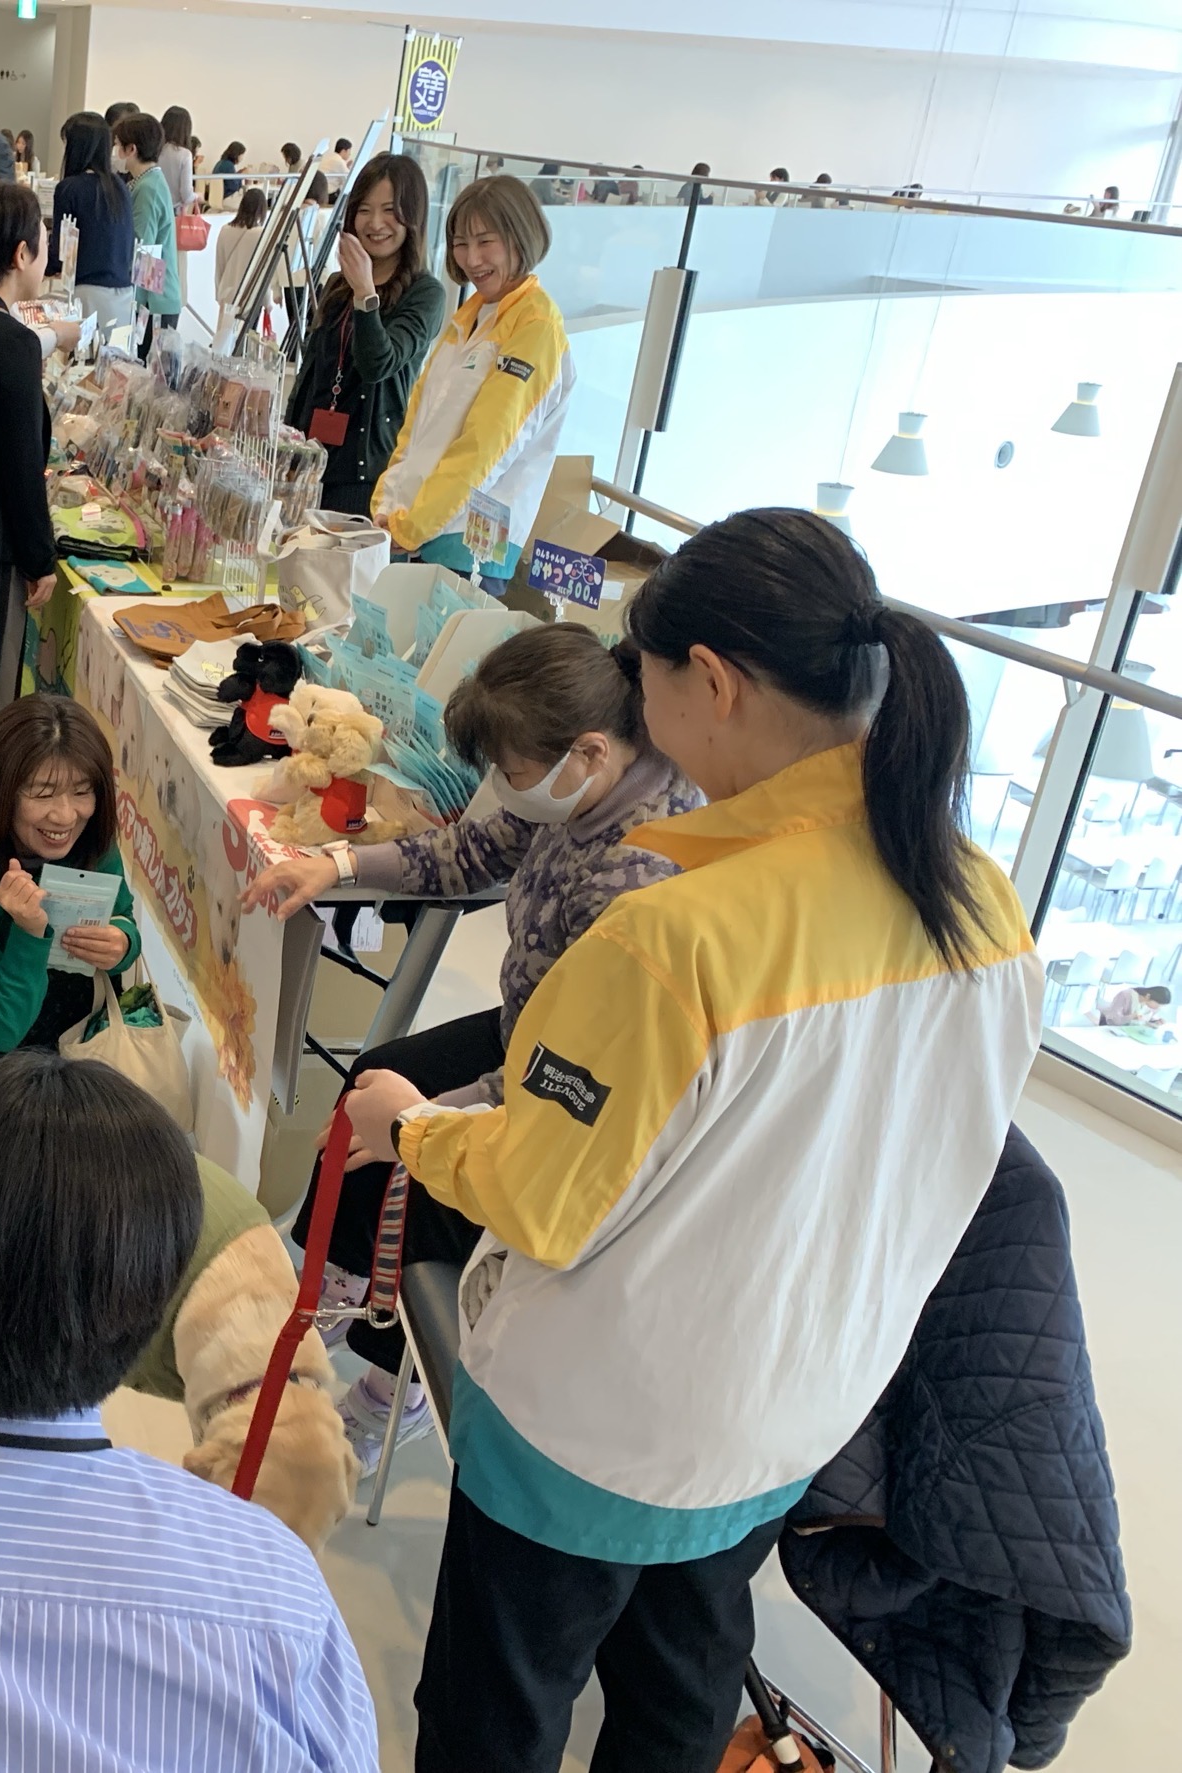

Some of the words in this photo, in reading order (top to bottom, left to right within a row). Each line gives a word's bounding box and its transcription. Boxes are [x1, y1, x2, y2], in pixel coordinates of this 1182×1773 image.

[416, 67, 446, 91] 完全
[413, 88, 443, 111] メシ
[536, 547, 566, 565] わんちゃんの
[531, 559, 563, 584] おやつ
[539, 1079, 586, 1111] J.LEAGUE
[542, 1063, 597, 1104] 明治安田生命
